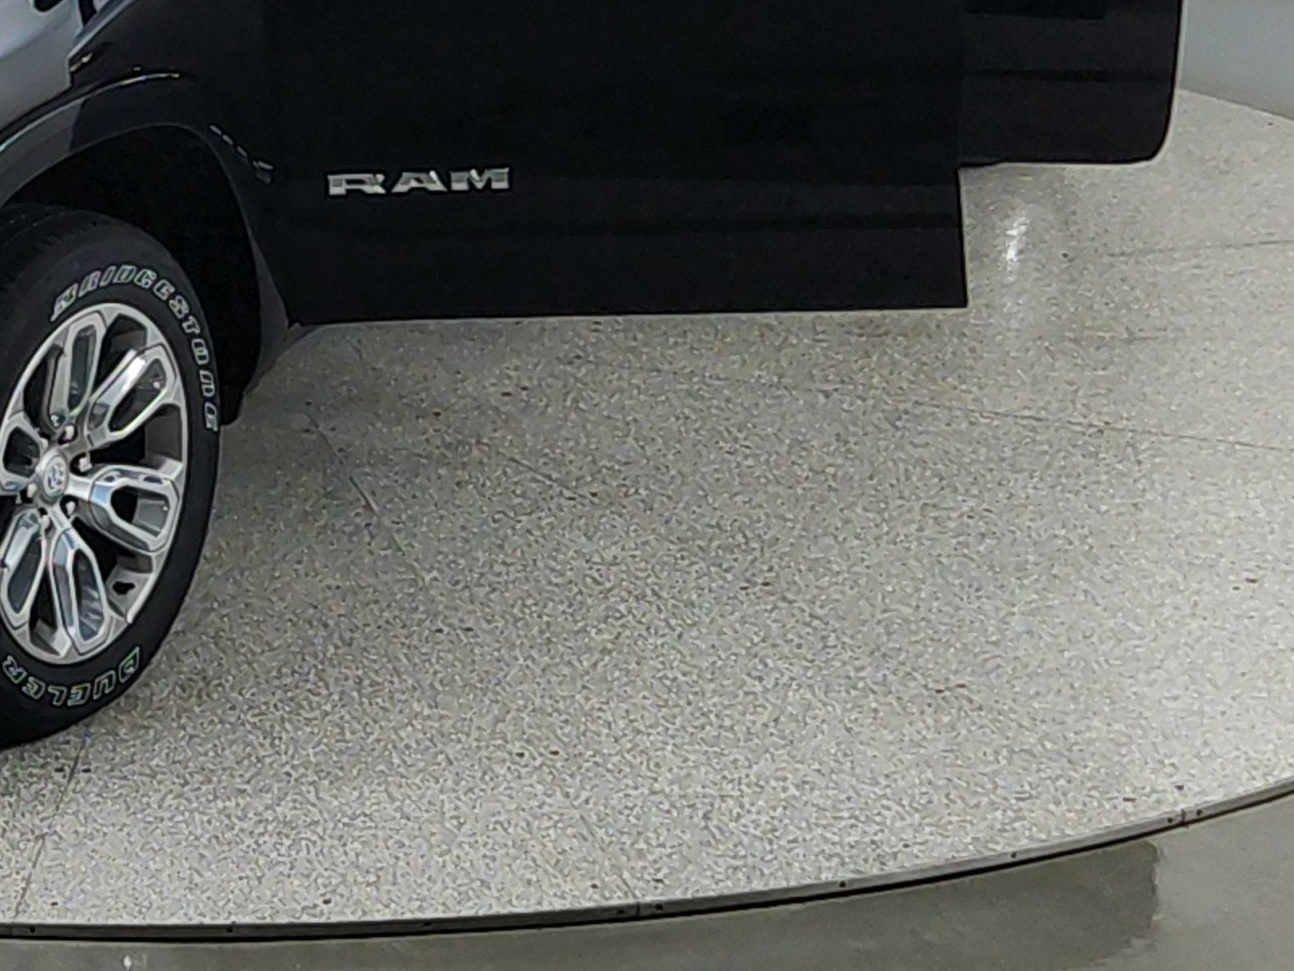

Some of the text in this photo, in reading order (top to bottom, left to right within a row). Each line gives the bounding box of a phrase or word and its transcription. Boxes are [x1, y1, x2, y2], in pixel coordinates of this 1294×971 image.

[327, 167, 510, 196] RAM
[50, 264, 219, 432] BRIDGESTONE
[1, 645, 141, 707] DUELER
